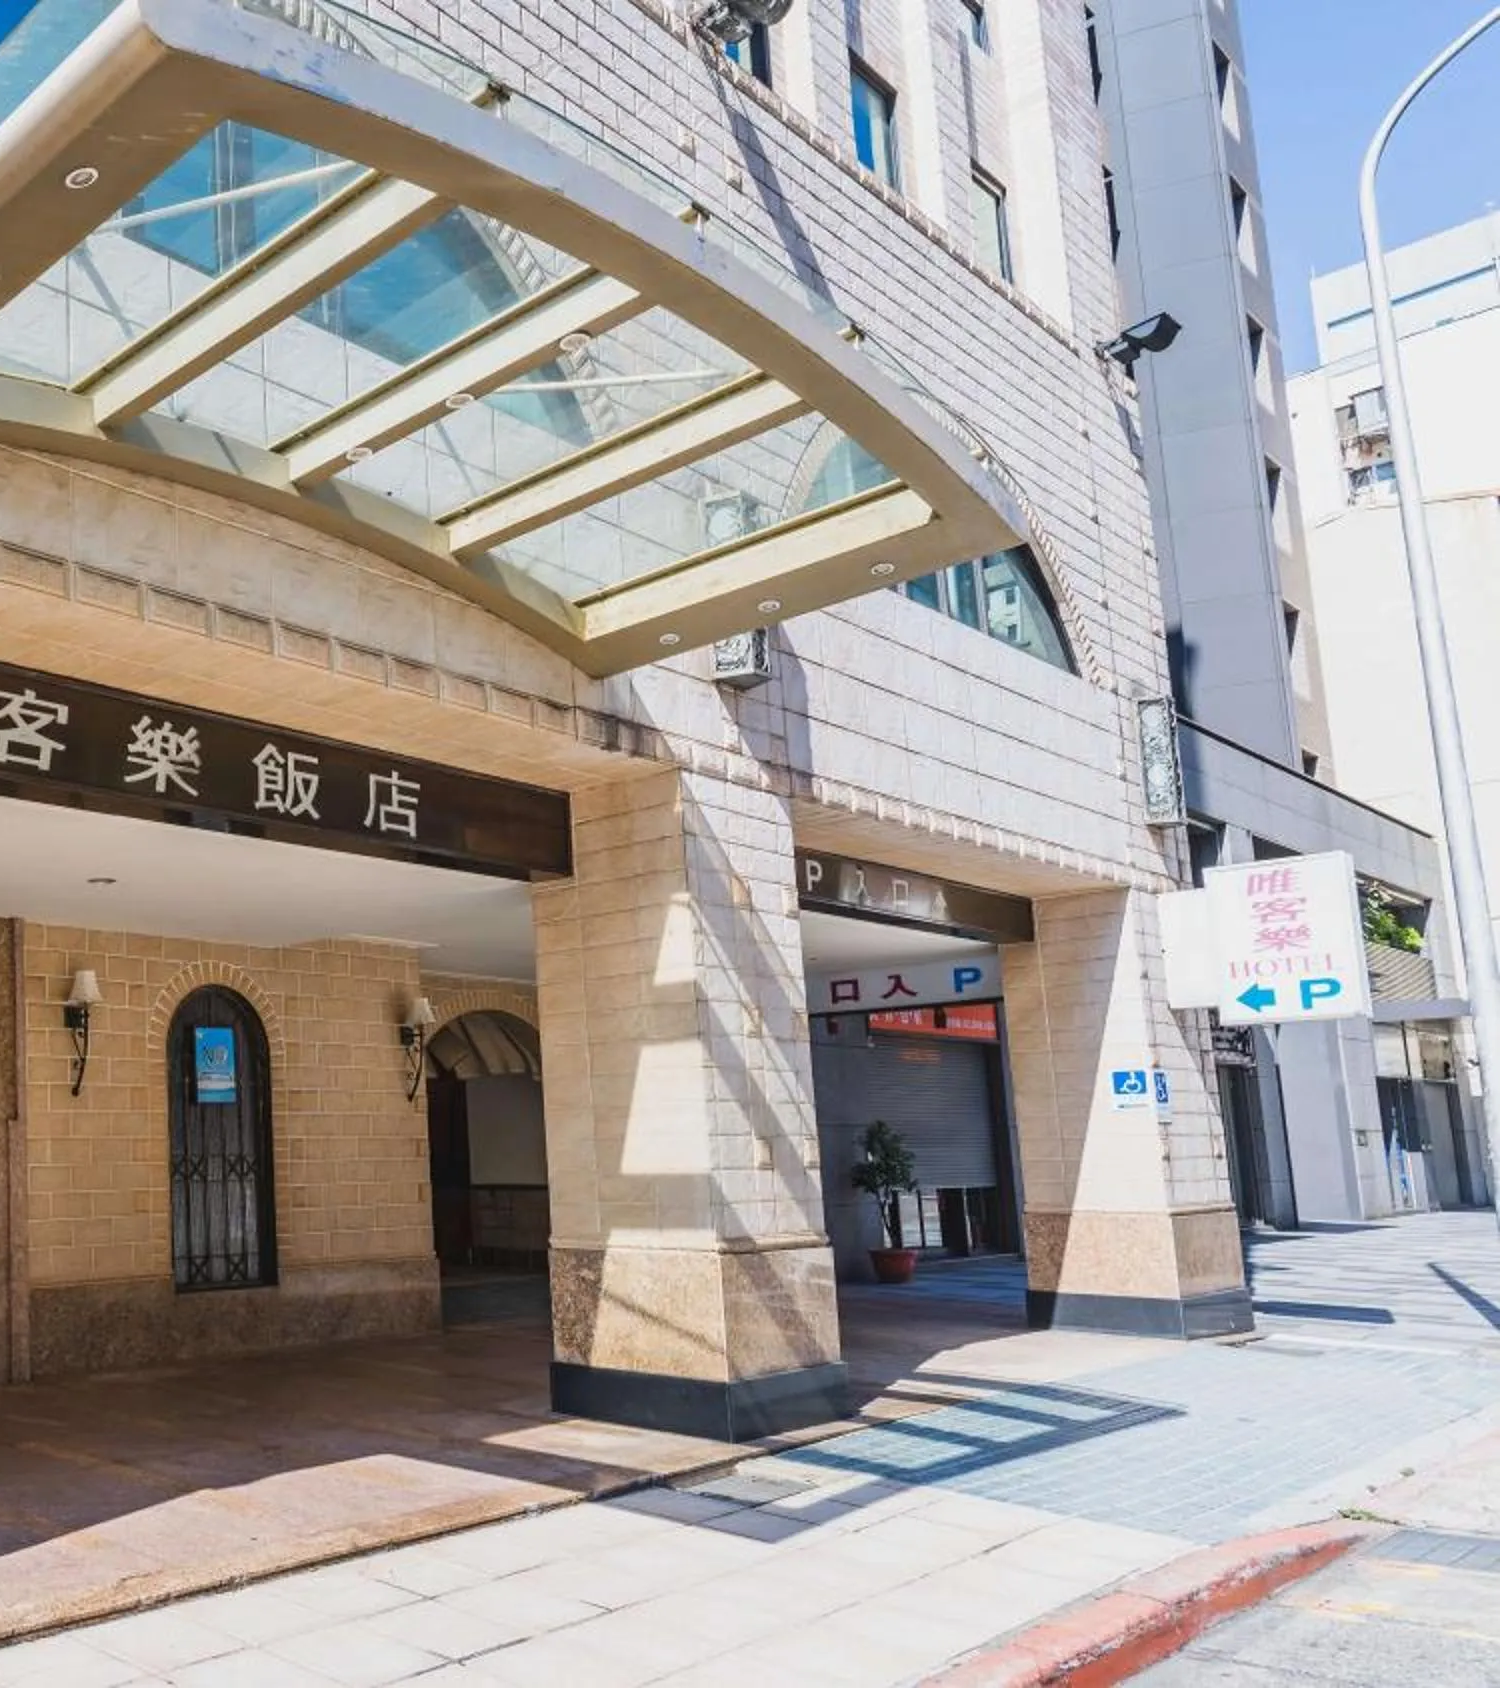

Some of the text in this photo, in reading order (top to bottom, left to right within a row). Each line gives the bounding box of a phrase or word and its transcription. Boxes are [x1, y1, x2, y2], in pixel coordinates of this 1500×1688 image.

[805, 859, 823, 892] P
[1247, 867, 1311, 953] 唯客樂
[953, 967, 982, 993] P
[1300, 977, 1341, 1010] P
